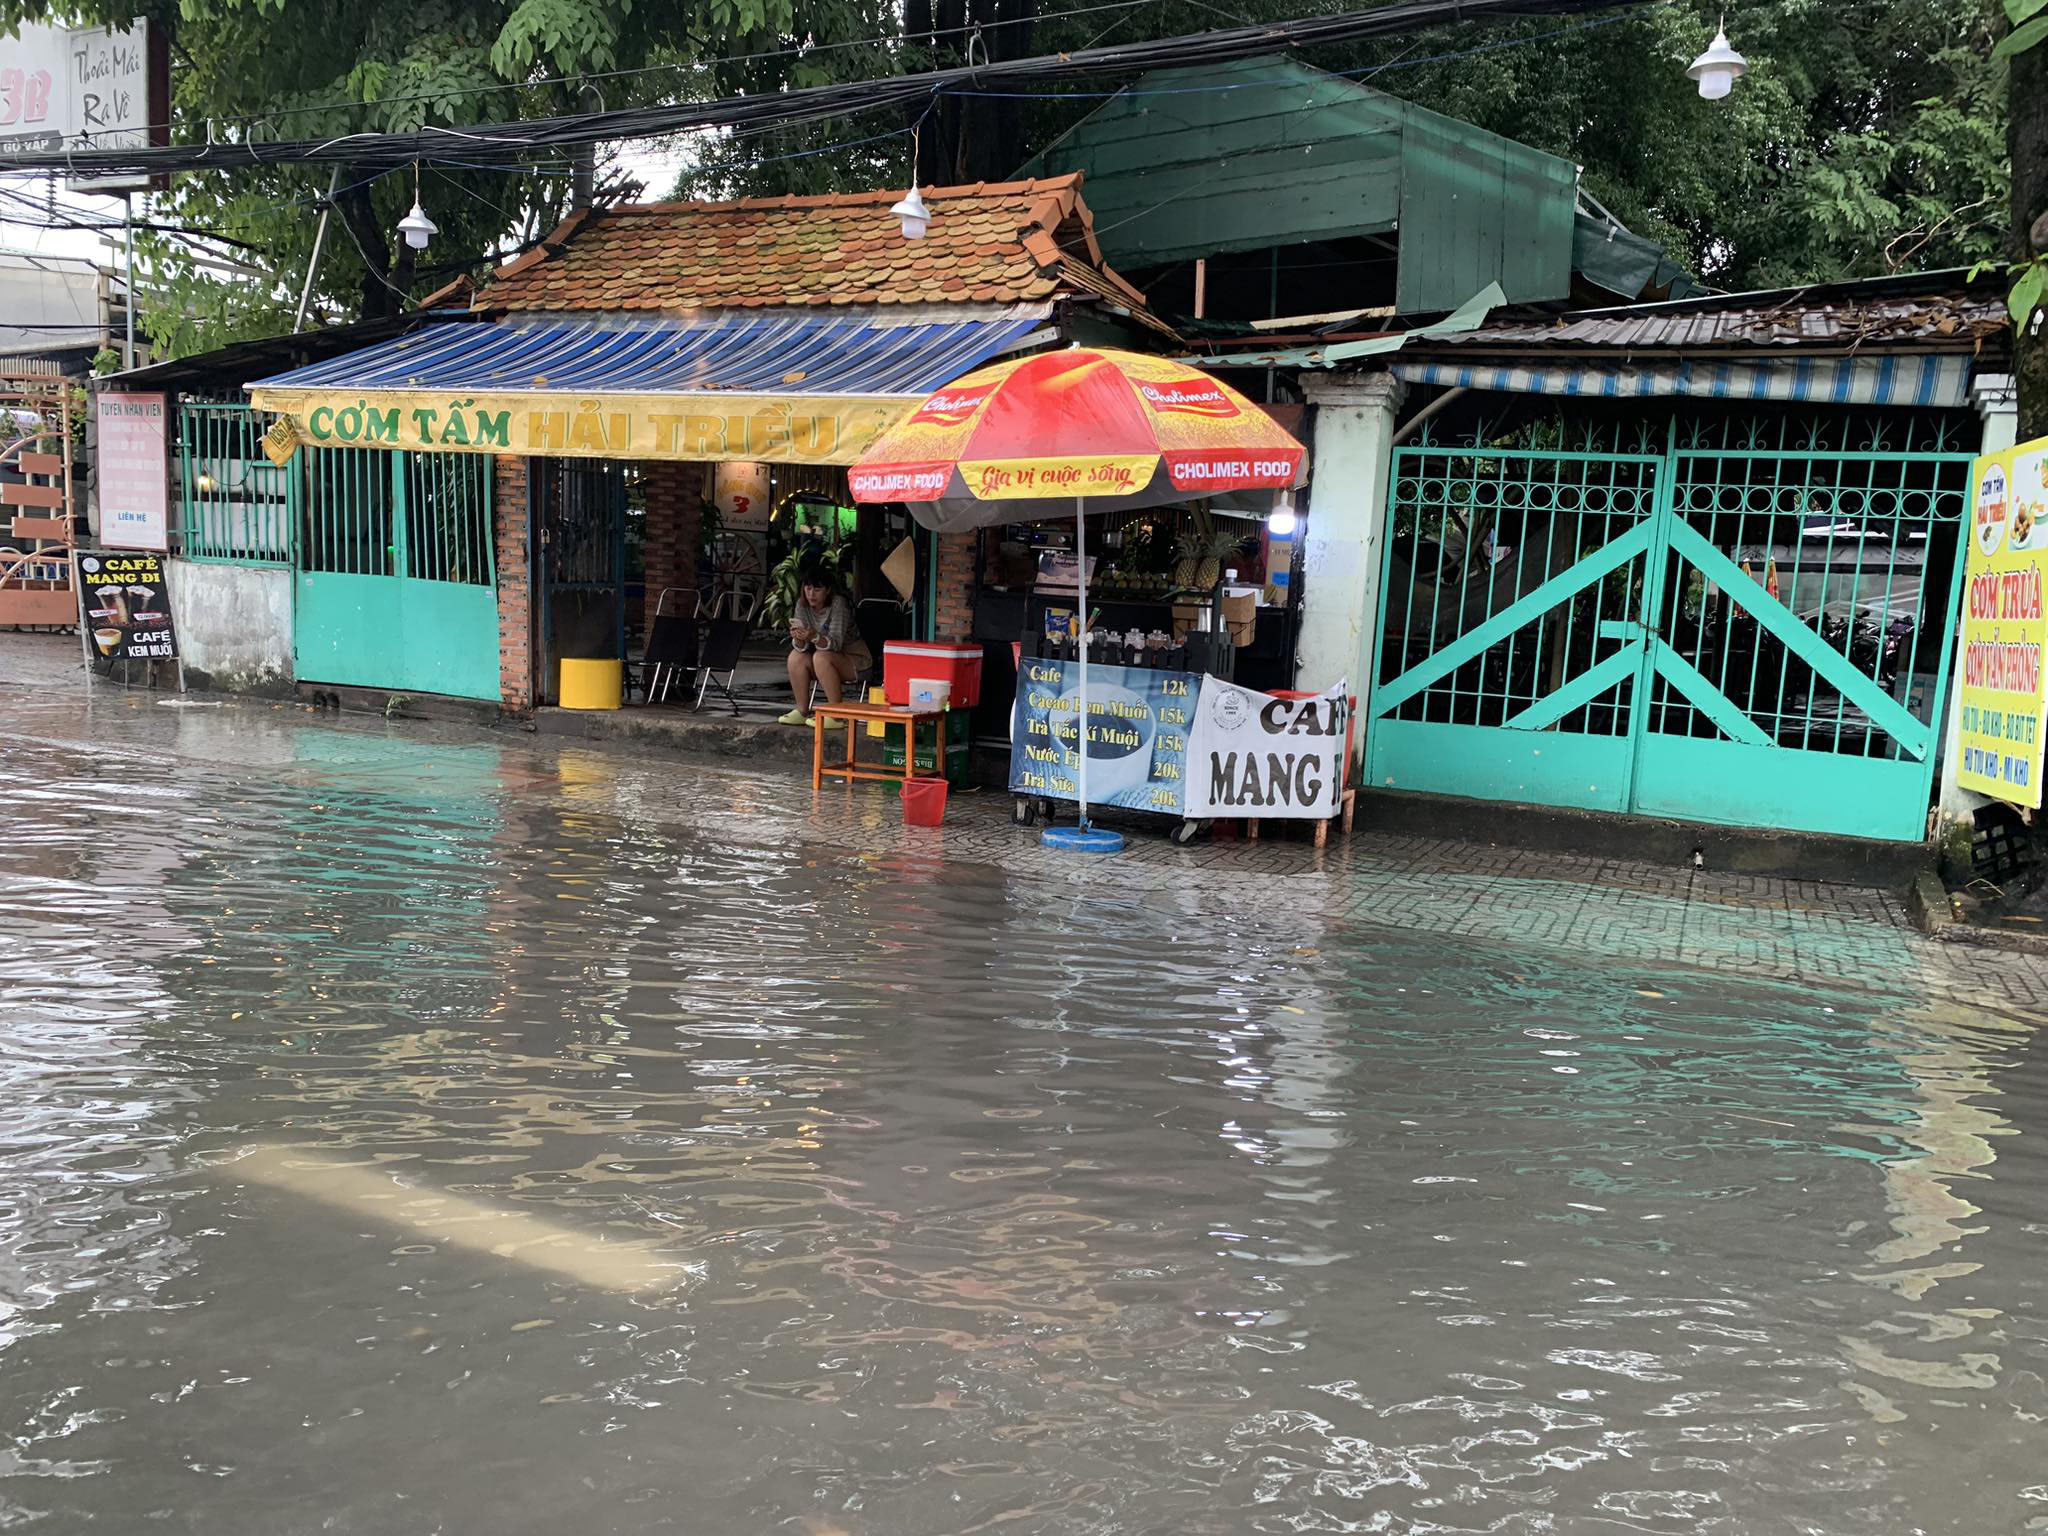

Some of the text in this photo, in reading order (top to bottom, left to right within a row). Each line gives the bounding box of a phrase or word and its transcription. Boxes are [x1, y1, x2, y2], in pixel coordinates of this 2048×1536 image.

[83, 93, 110, 127] Ra
[1141, 386, 1226, 403] Cholimex
[309, 398, 840, 457] CƠM TẤM HẢI TRIỀU
[854, 472, 944, 491] CHOLIMEX FOOD
[979, 462, 1135, 497] Gia vị cuộc sống
[1174, 461, 1291, 480] CHOLIMEX FOOD
[85, 572, 160, 584] MANG ĐI
[105, 557, 158, 571] CAFÉ
[1970, 560, 2043, 619] CƠM TRƯA
[128, 645, 149, 657] KEM
[133, 630, 171, 643] CAFÉ
[1966, 633, 1985, 688] CƠM
[2006, 628, 2041, 694] PHÒNG
[1029, 665, 1188, 696] Cafe 12k
[1028, 691, 1069, 710] Cacao
[1109, 698, 1148, 720] Muối
[1159, 707, 1185, 724] 15k
[1026, 718, 1048, 736] Trà
[1053, 719, 1078, 739] Tắc
[1101, 727, 1139, 751] Muội
[1156, 735, 1183, 752] 15k
[1024, 744, 1060, 764] Nước
[1153, 761, 1180, 779] 20k
[1022, 771, 1177, 806] Trà Sữa 20k
[1209, 751, 1322, 807] MANG
